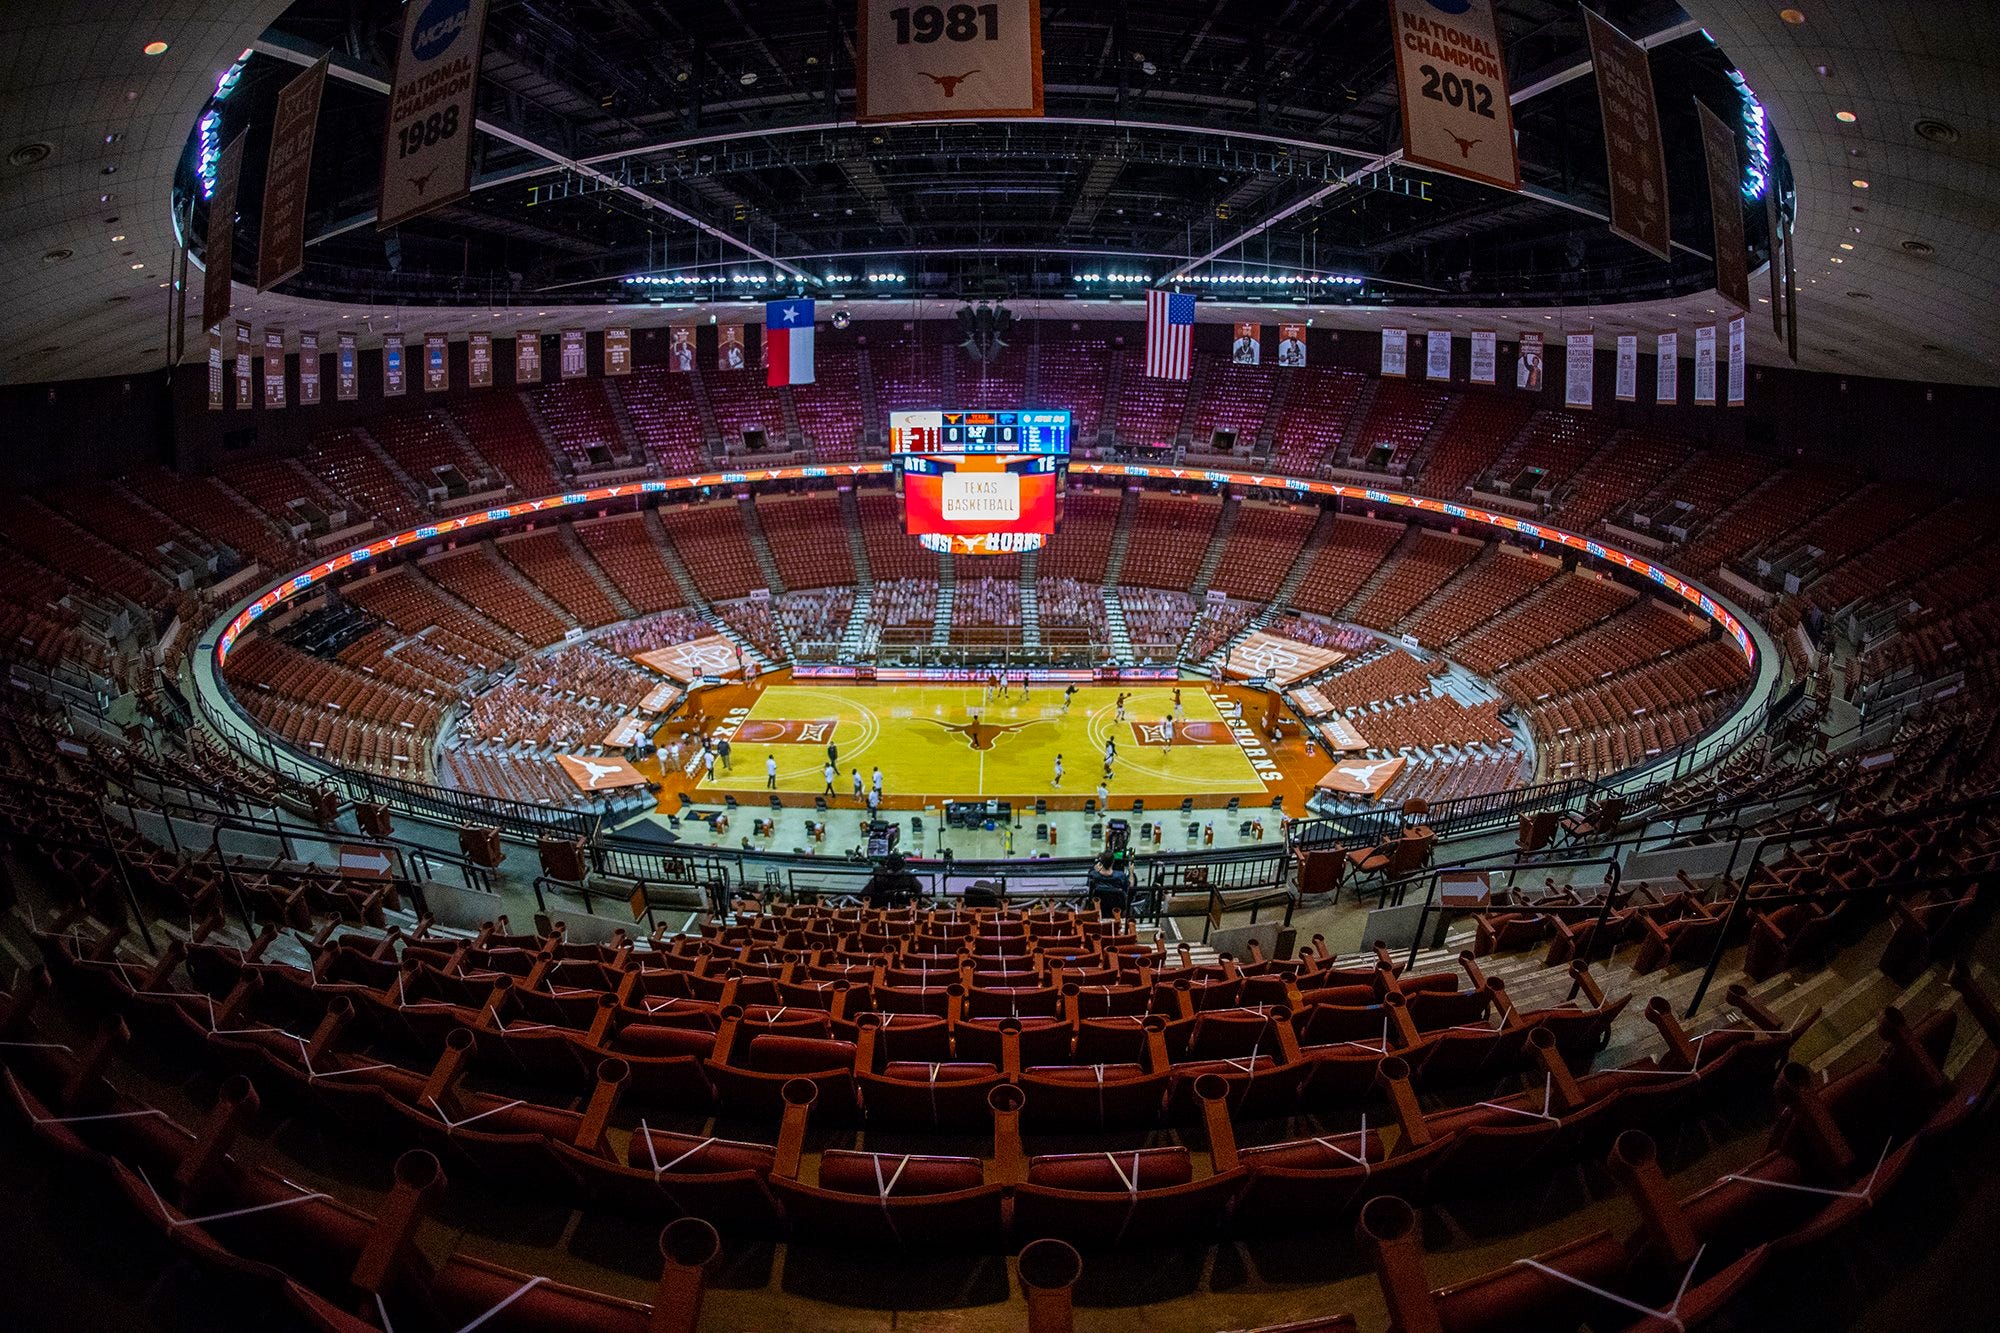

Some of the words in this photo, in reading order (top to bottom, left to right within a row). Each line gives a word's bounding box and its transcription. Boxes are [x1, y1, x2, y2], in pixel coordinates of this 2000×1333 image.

[889, 4, 999, 45] 1981
[1401, 11, 1495, 60] NATIONAL
[397, 55, 472, 104] NATIONAL
[1404, 33, 1499, 81] CHAMPION
[393, 72, 471, 122] CHAMPION
[1420, 64, 1495, 119] 2012
[398, 104, 460, 159] 1988
[949, 427, 958, 441] 0
[1003, 427, 1012, 441] 0
[947, 499, 1015, 511] BASKETBALL
[964, 482, 999, 494] TEXAS
